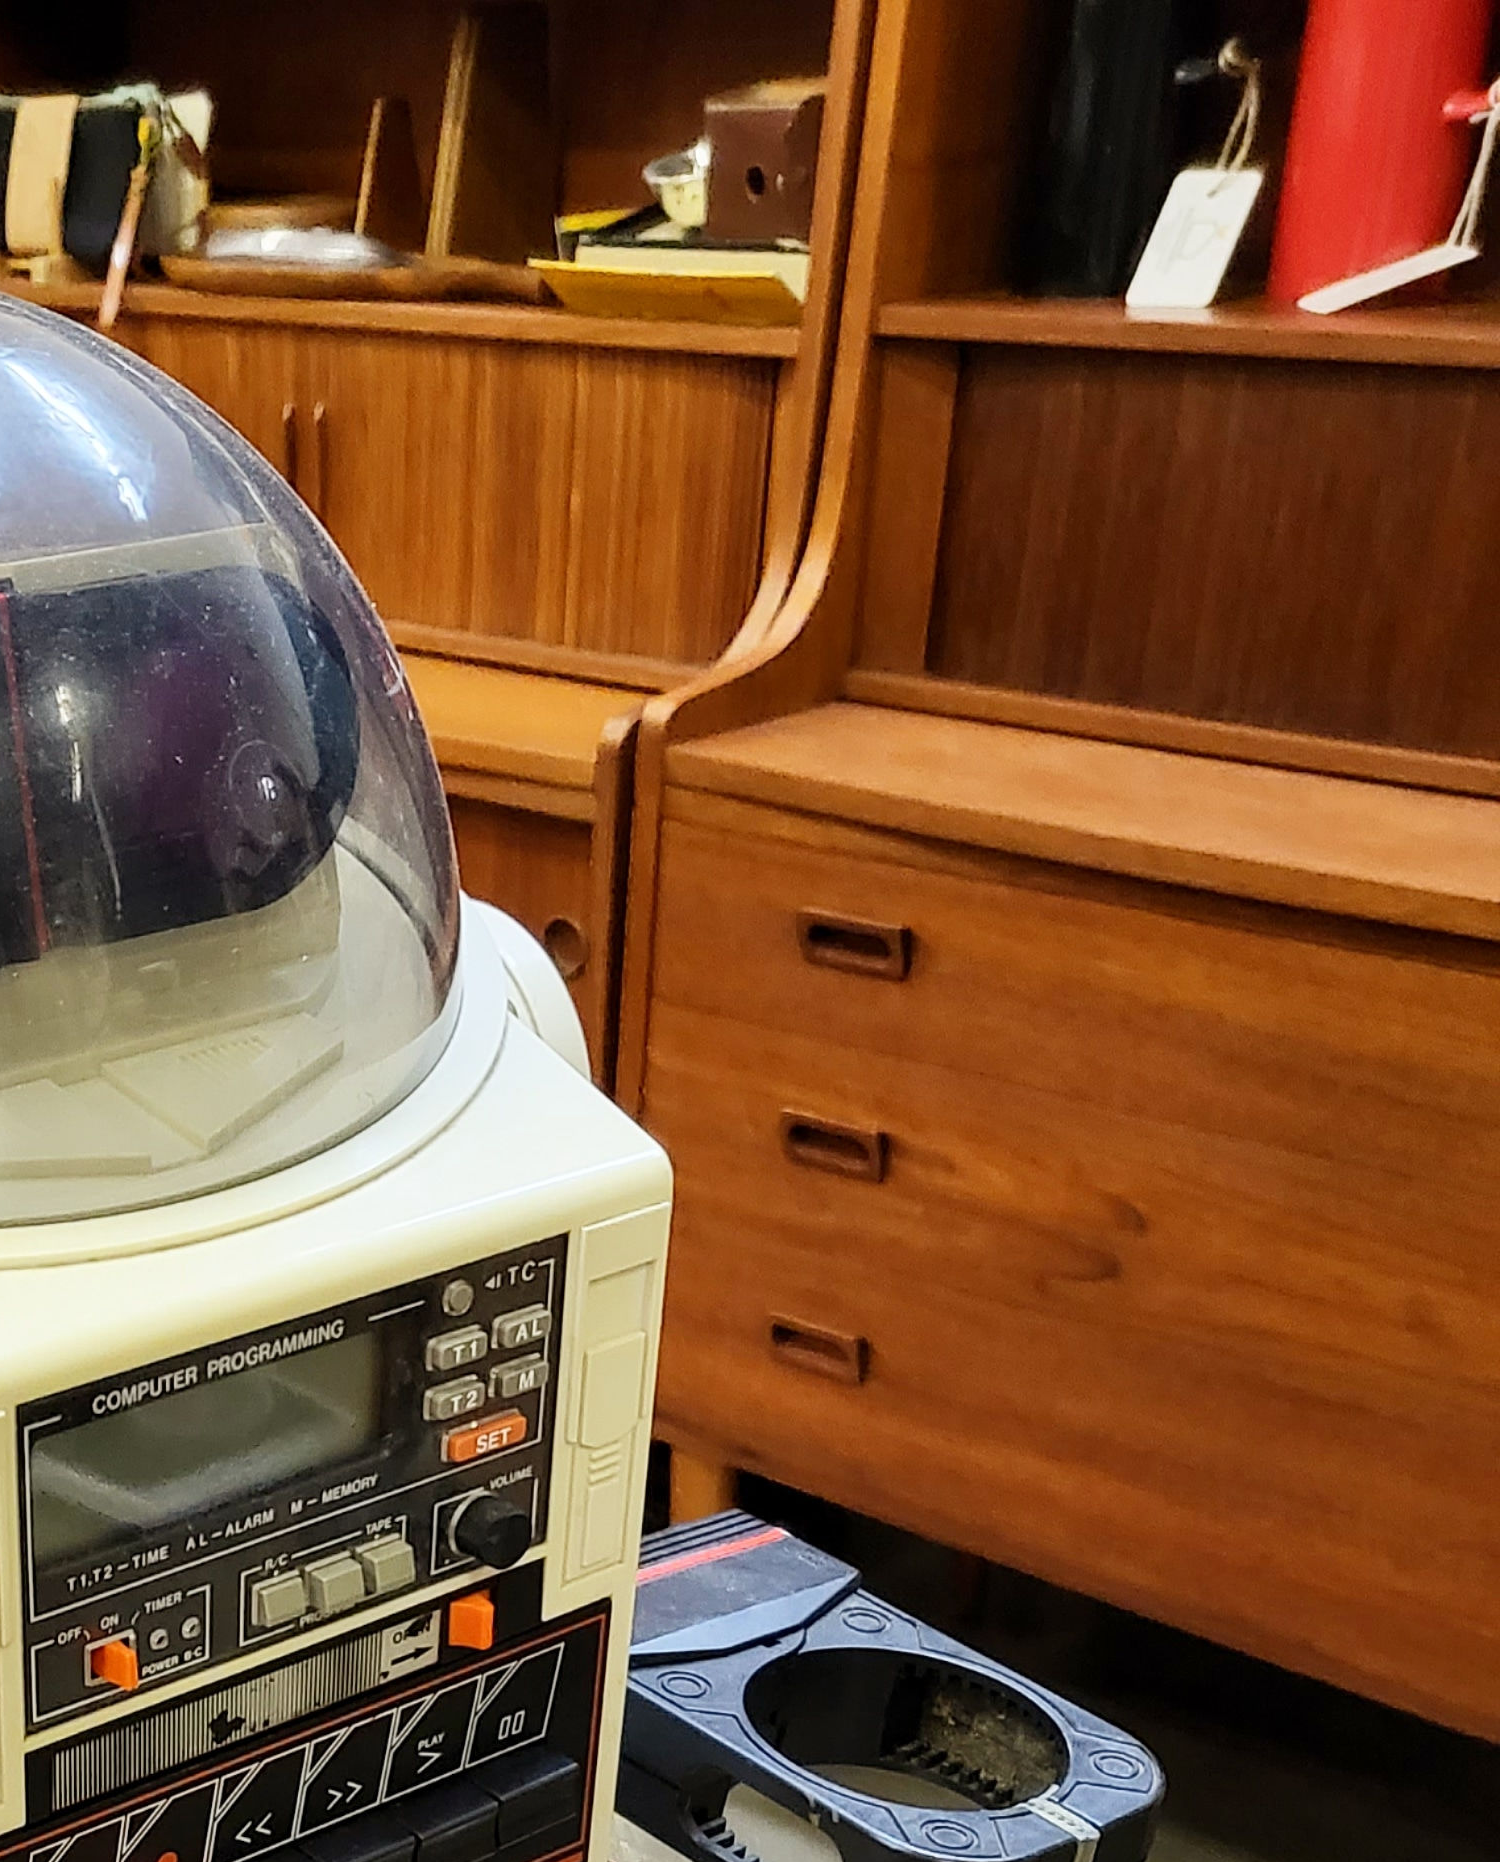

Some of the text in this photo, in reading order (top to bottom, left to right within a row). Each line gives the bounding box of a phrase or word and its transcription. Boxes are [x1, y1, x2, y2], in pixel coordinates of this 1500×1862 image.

[515, 1319, 543, 1343] AL
[452, 1341, 479, 1364] T1
[92, 1319, 345, 1415] COMPUTER PROGRAMMING
[518, 1370, 535, 1391] M
[450, 1390, 479, 1413] T2
[476, 1427, 512, 1454] SET
[490, 1466, 533, 1491] VOLUME
[365, 1517, 393, 1535] TAPE
[58, 1591, 182, 1645] OFF ON TIMER
[142, 1655, 179, 1677] POWER
[418, 1733, 445, 1751] PLAY
